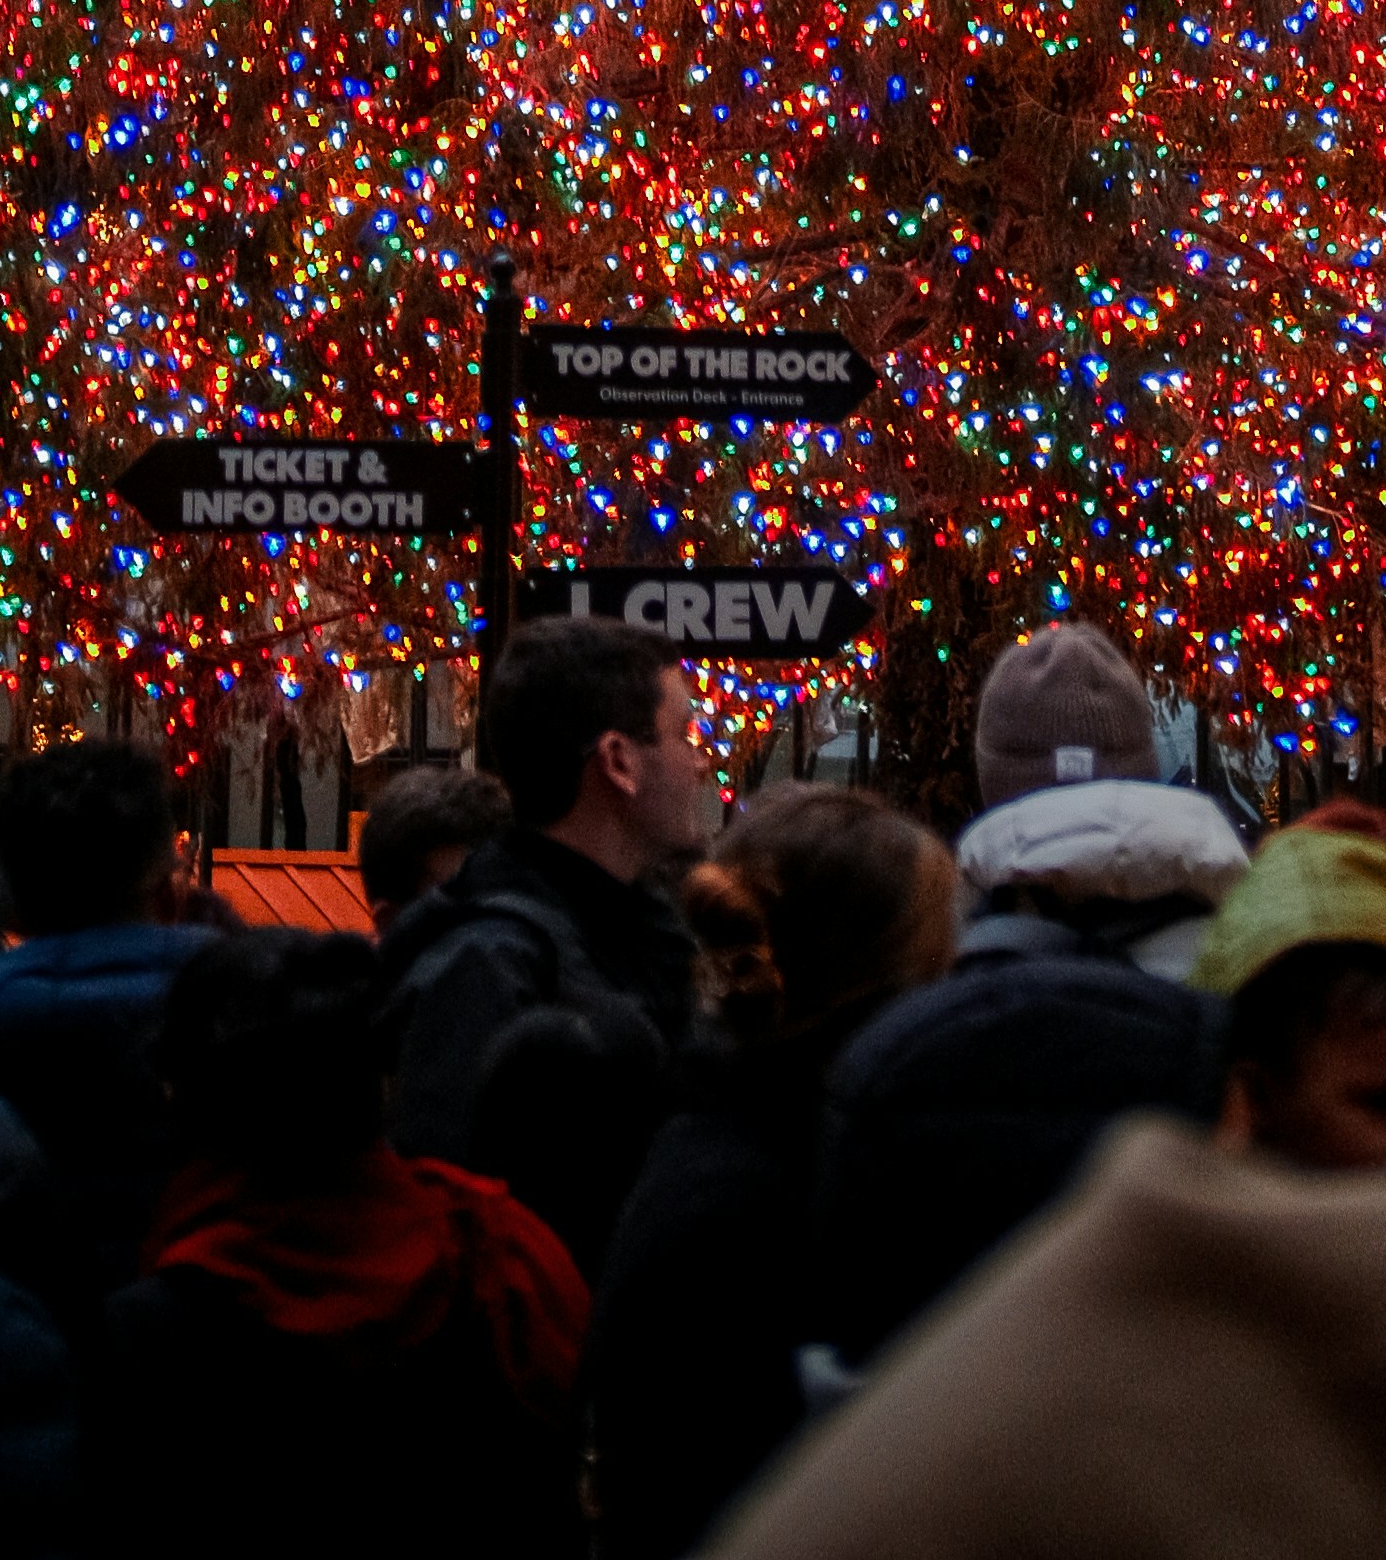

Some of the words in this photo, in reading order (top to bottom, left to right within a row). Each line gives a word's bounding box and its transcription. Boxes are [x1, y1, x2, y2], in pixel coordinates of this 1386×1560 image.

[552, 343, 623, 377] TOP
[630, 346, 677, 378] OF
[684, 348, 748, 379] THE
[756, 349, 852, 382] ROCK
[599, 386, 689, 404] Observation
[692, 388, 727, 404] Deck
[741, 389, 804, 406] Entrance
[218, 447, 350, 483] TICKET
[357, 448, 388, 484] &
[182, 489, 276, 526] INFO
[282, 490, 424, 527] BOOTH
[623, 580, 835, 641] CREW
